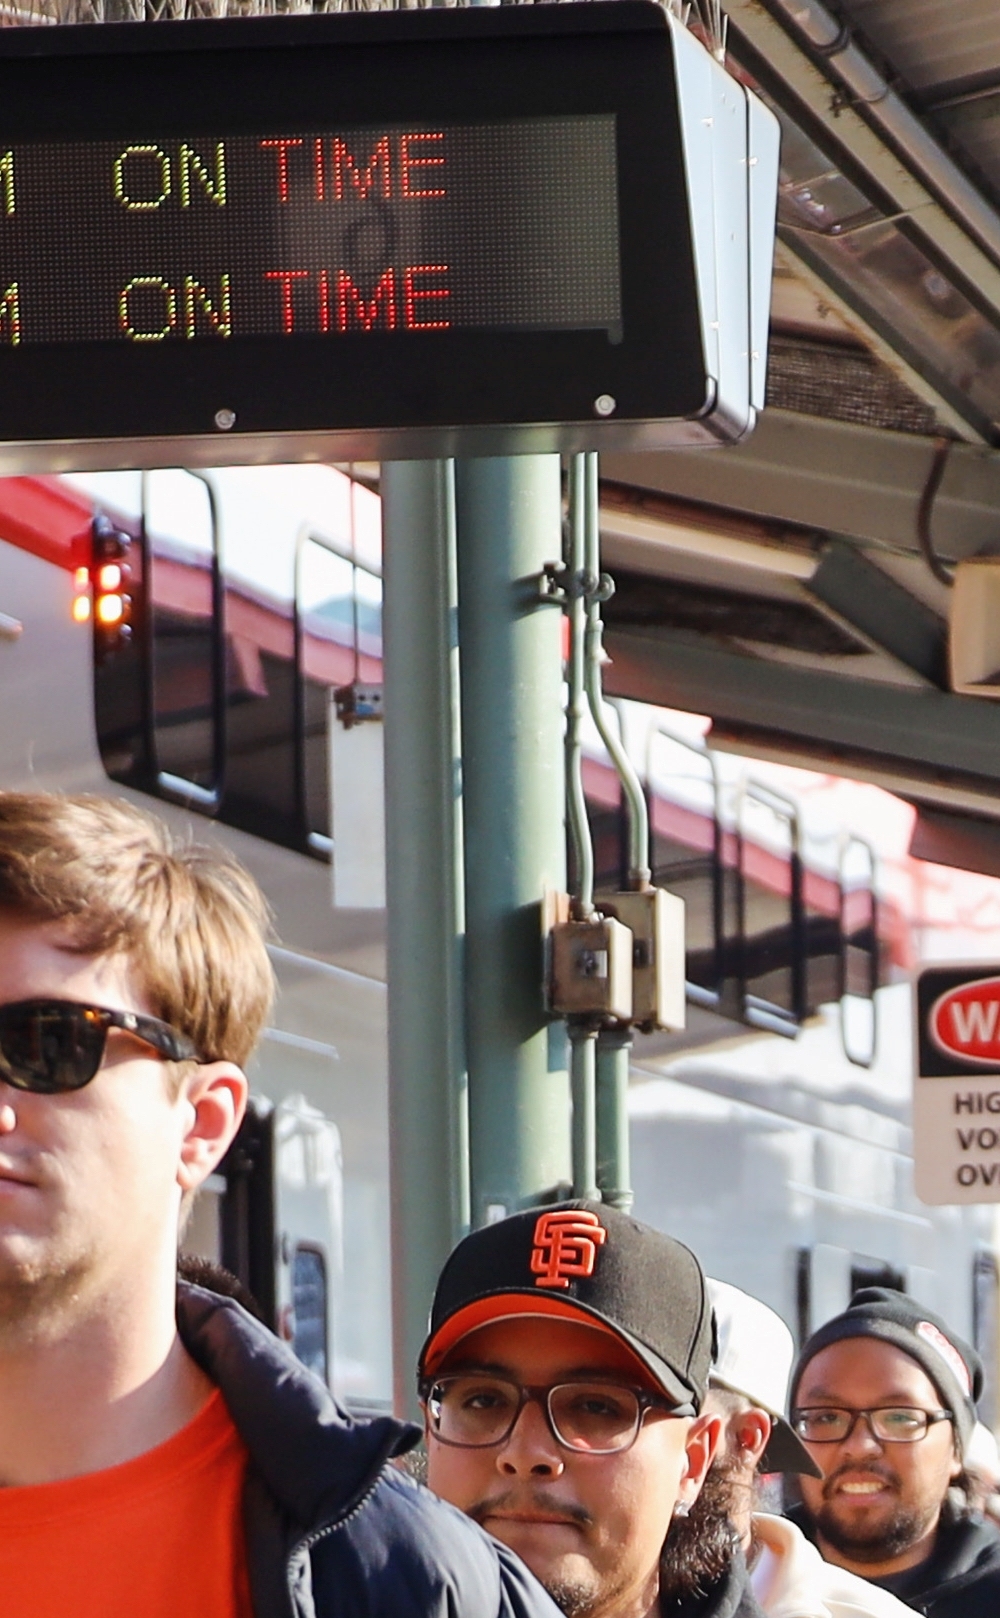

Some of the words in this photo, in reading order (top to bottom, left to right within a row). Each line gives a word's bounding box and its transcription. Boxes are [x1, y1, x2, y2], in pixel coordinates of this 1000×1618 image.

[114, 143, 227, 210] ON
[260, 132, 447, 202] TIME
[119, 274, 231, 341] ON
[264, 264, 451, 333] TIME
[951, 1000, 1000, 1043] W
[957, 1127, 1000, 1151] VO
[957, 1163, 1000, 1186] OV
